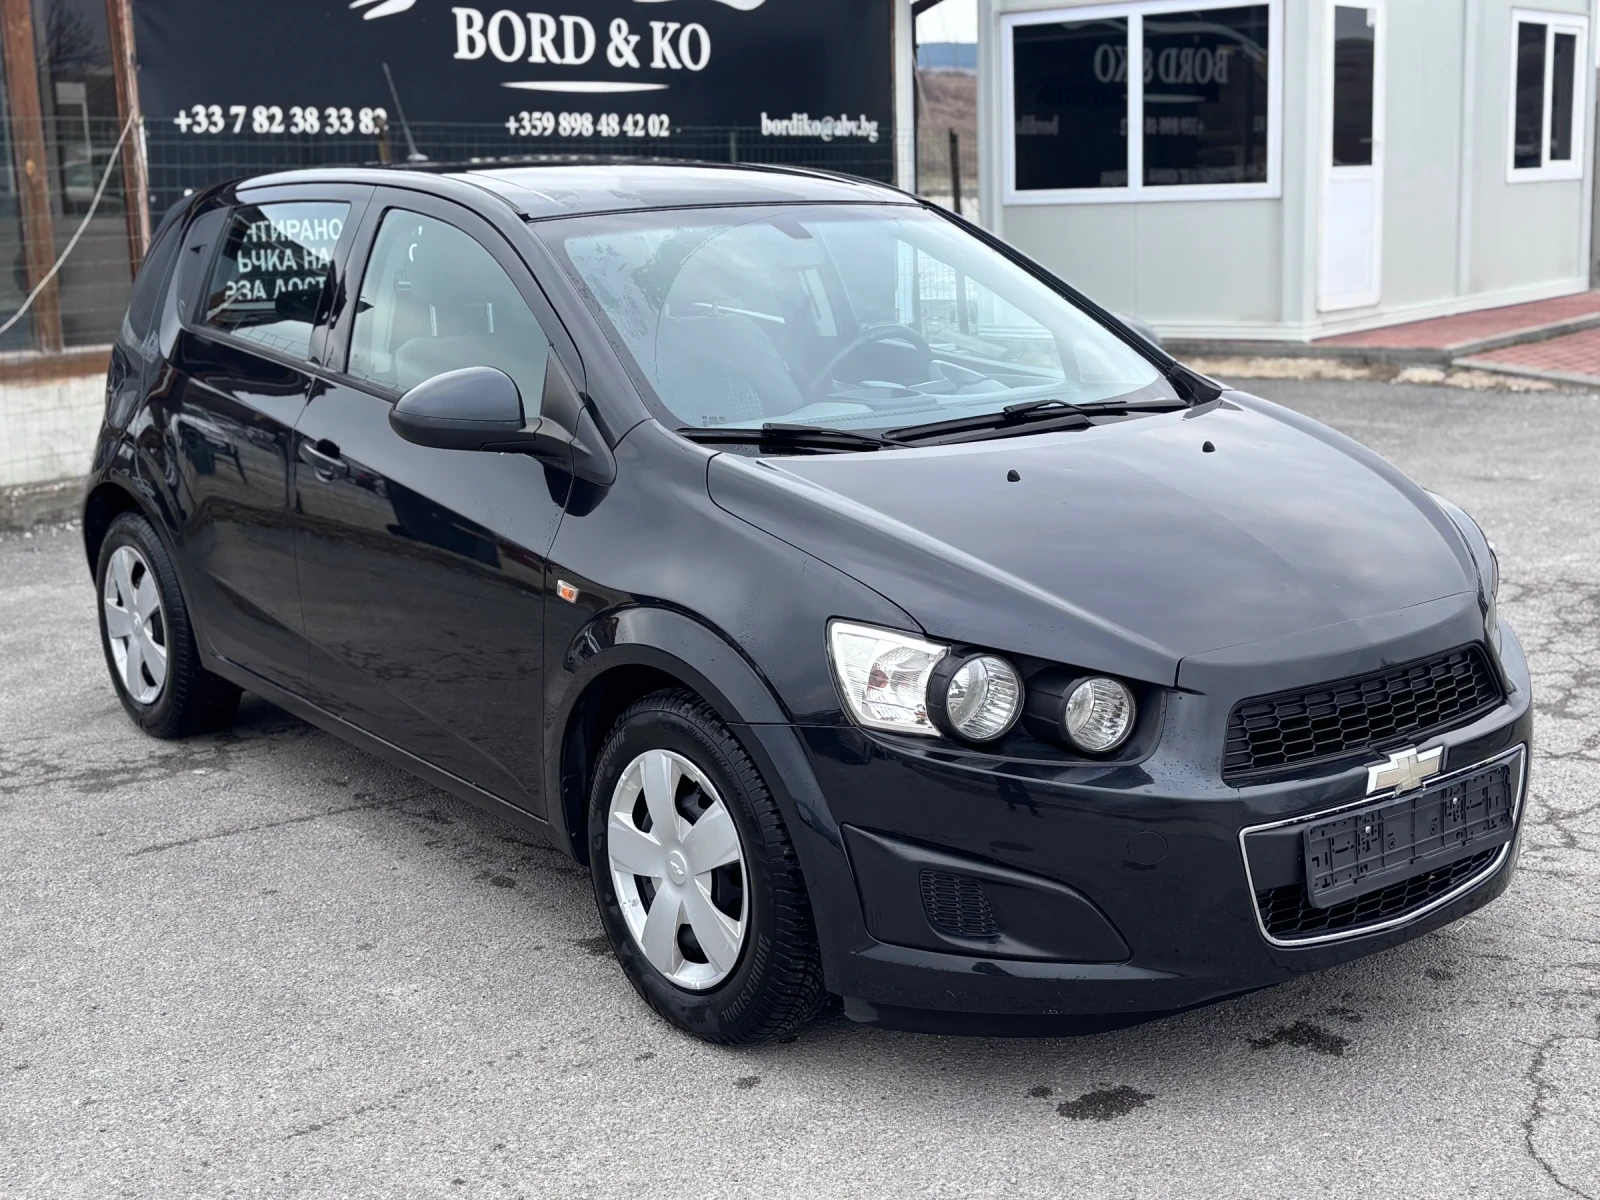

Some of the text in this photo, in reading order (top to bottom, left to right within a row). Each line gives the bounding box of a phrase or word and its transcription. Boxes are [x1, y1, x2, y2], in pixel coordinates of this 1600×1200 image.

[451, 7, 711, 71] BORD & KO
[173, 104, 225, 134] +33
[229, 105, 247, 134] 7
[252, 105, 285, 134] 82
[289, 106, 320, 134] 38
[324, 107, 354, 135] 33
[505, 111, 670, 137] +359 898 48 42 02
[761, 111, 879, 143] bordiko@abv.bg
